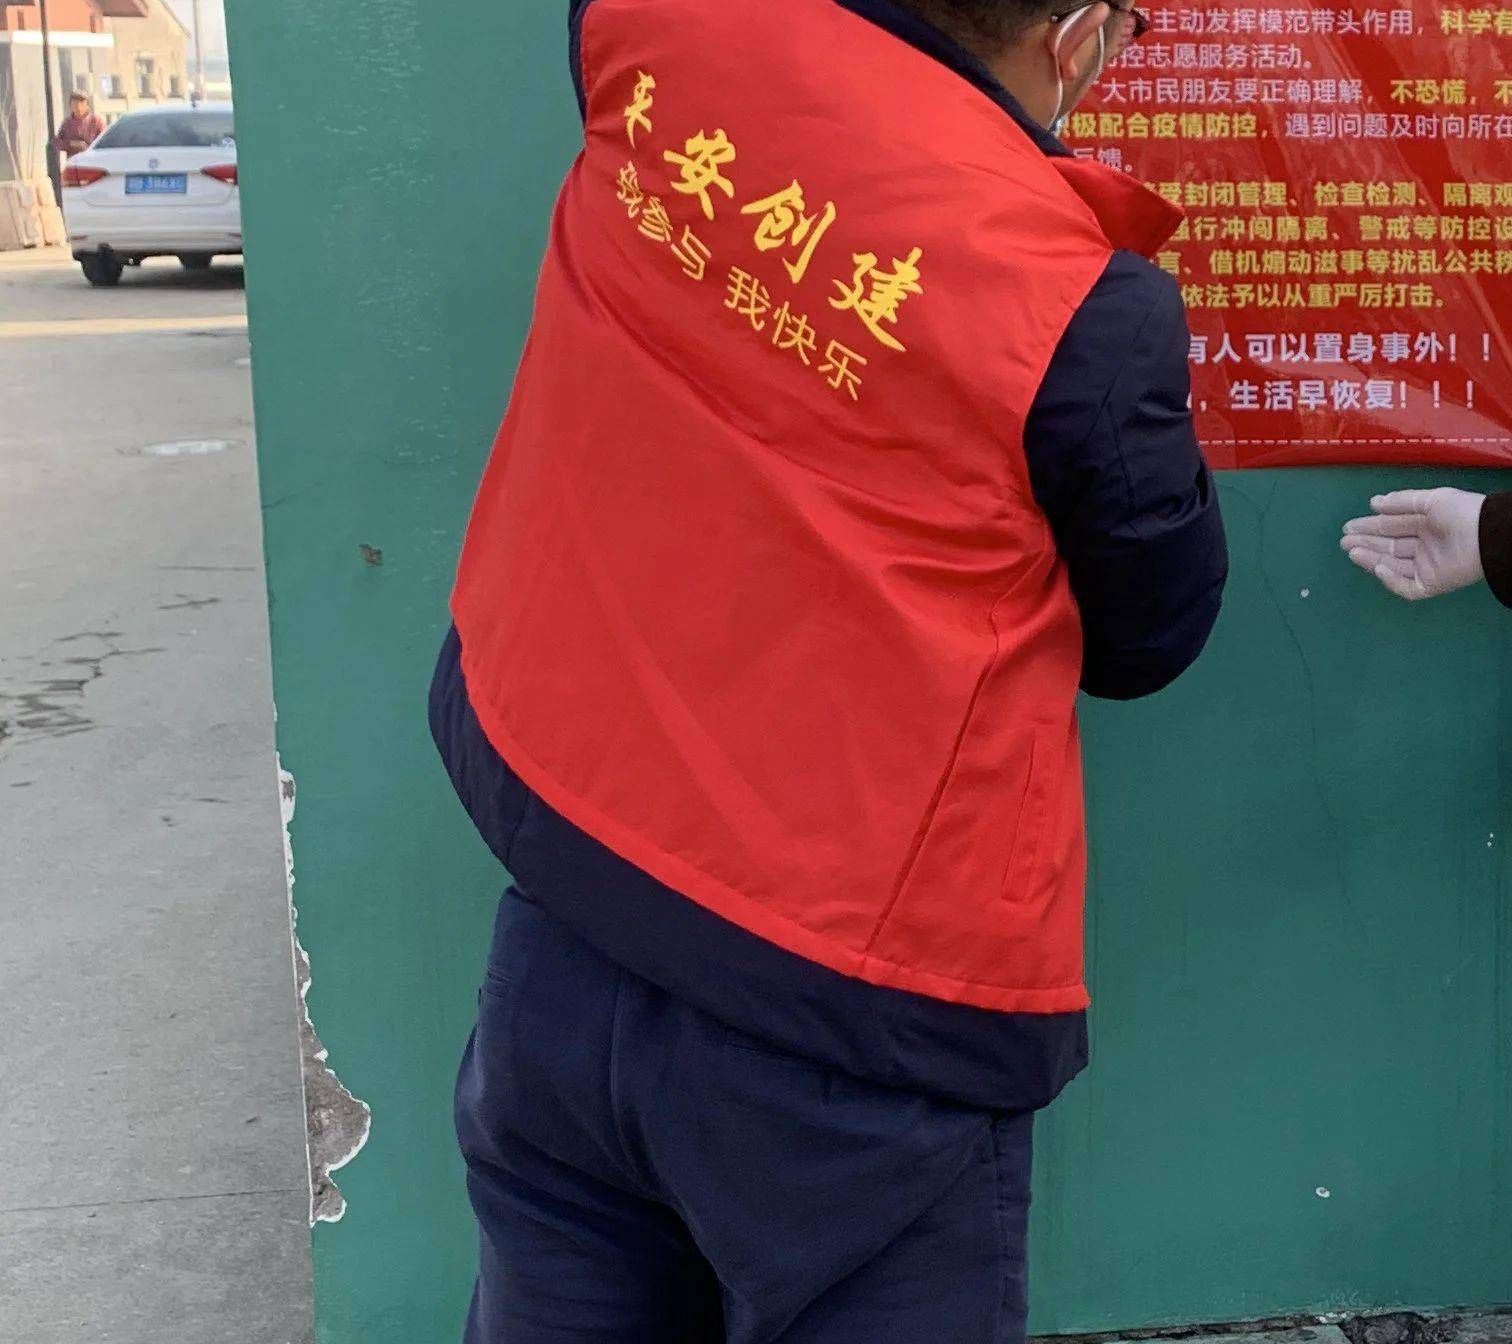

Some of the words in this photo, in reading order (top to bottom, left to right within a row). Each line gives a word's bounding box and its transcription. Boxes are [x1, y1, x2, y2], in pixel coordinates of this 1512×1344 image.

[1107, 42, 1314, 70] 控志愿服务活动。
[1181, 282, 1445, 308] 依法予以从重严厉打击。
[724, 265, 868, 401] 我快乐
[1186, 379, 1474, 412] ，生活早恢复！！！
